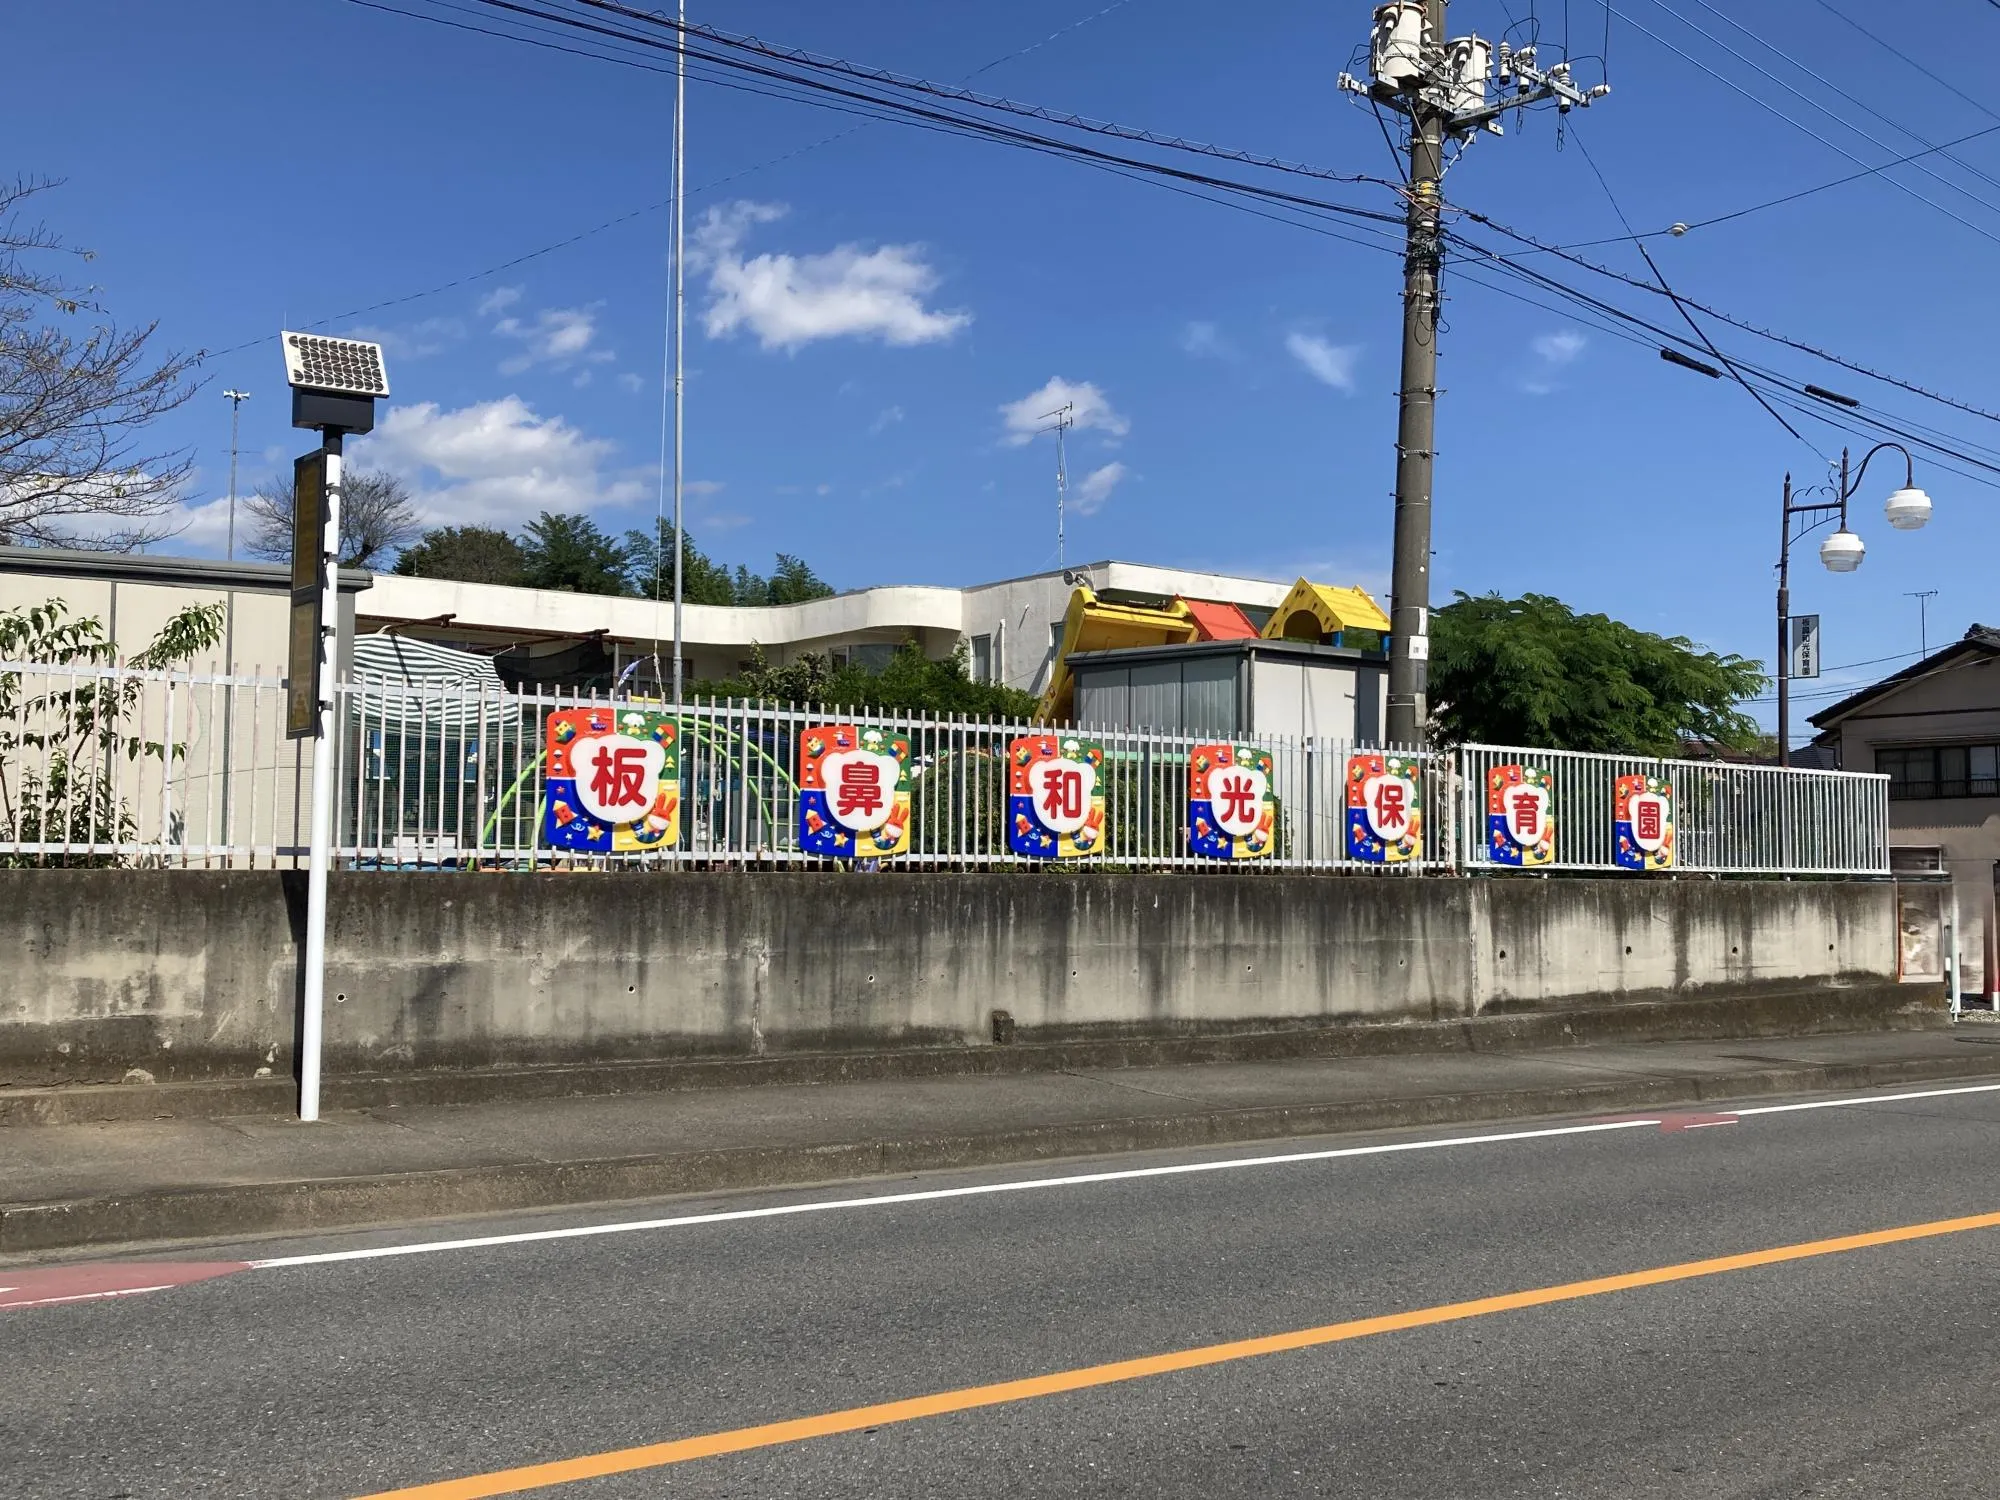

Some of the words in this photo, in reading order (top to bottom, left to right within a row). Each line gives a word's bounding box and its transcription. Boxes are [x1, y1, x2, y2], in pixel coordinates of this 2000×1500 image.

[590, 746, 647, 807] 板
[837, 761, 883, 817] 鼻
[1043, 768, 1082, 819] 和
[1220, 776, 1255, 824] 光
[1374, 784, 1405, 827] 保
[1512, 793, 1540, 834] 育
[1637, 800, 1661, 840] 園
